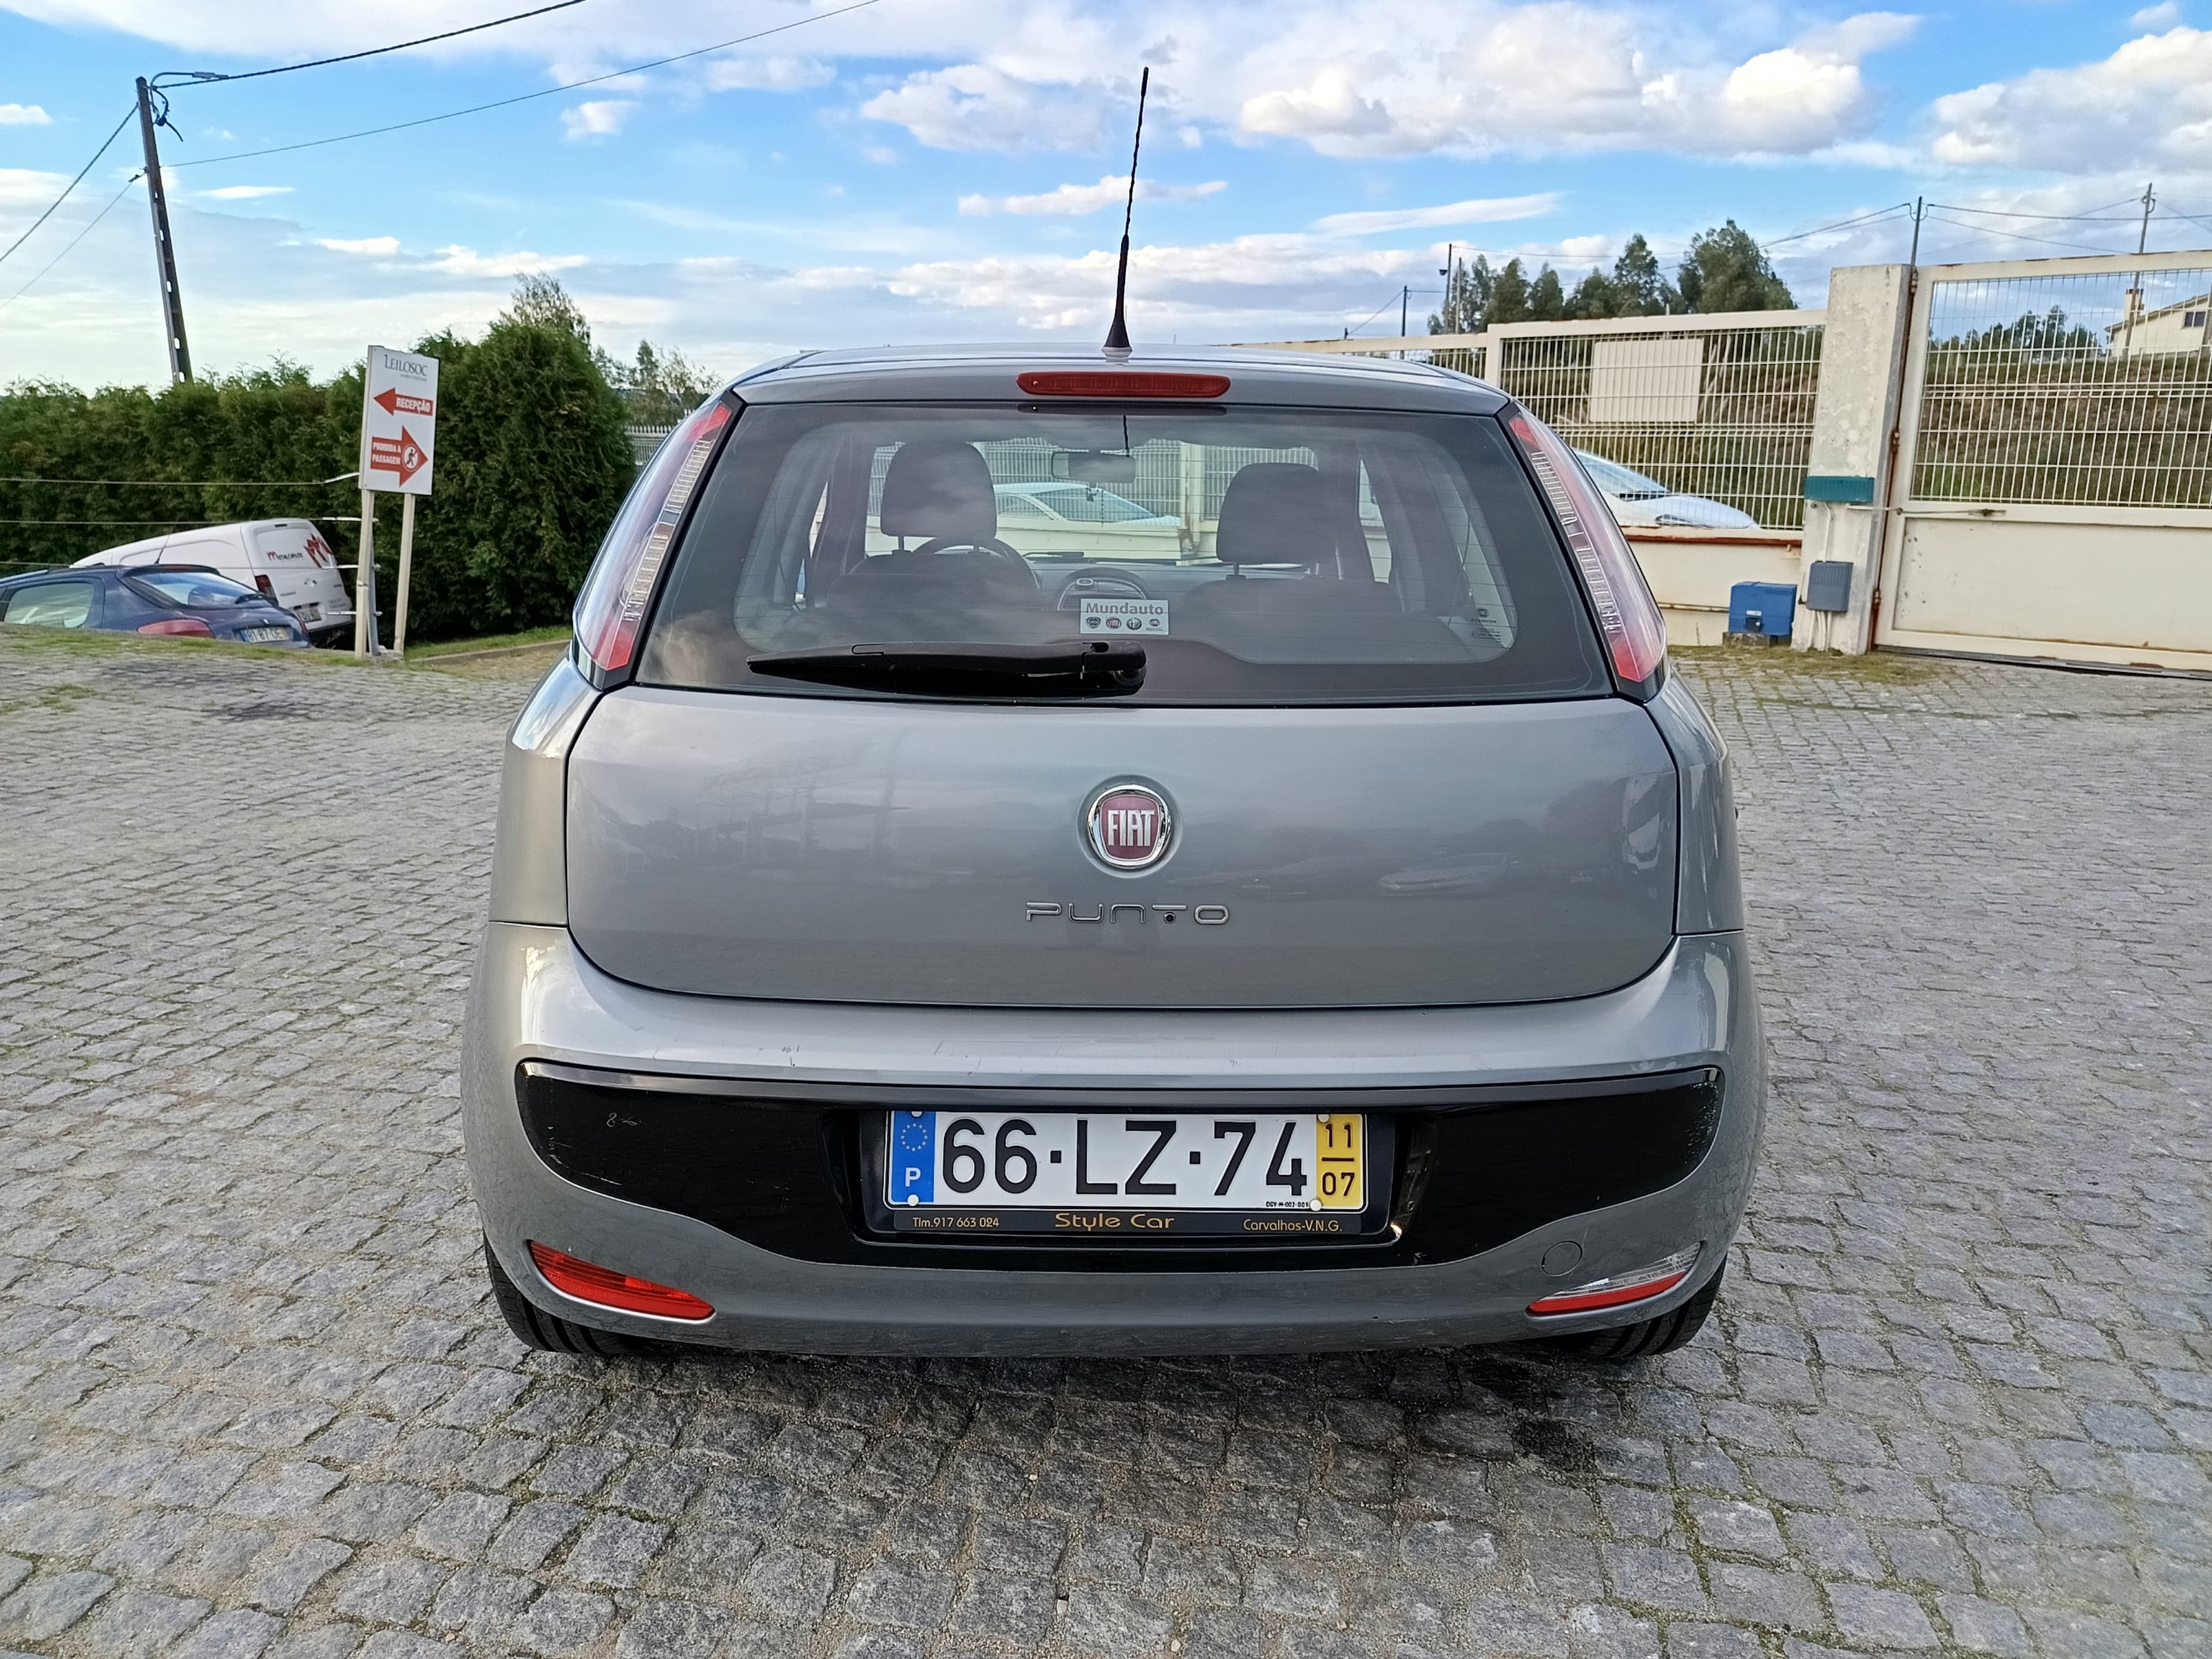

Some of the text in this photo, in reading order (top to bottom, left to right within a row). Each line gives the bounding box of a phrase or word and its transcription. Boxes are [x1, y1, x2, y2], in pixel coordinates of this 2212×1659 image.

[396, 397, 431, 414] RECEPÇÃO
[372, 454, 401, 465] PASSAGEM
[1085, 603, 1164, 615] Mundauto
[1107, 809, 1155, 847] FIAT
[1025, 902, 1230, 925] PUNTO
[1325, 1123, 1351, 1148] 11
[905, 1167, 921, 1187] P
[1322, 1172, 1355, 1196] 07
[956, 1217, 976, 1228] 663
[979, 1217, 999, 1228] 024
[1055, 1213, 1175, 1231] Style Car
[1243, 1218, 1343, 1232] Carvalhos-V.N.G.
